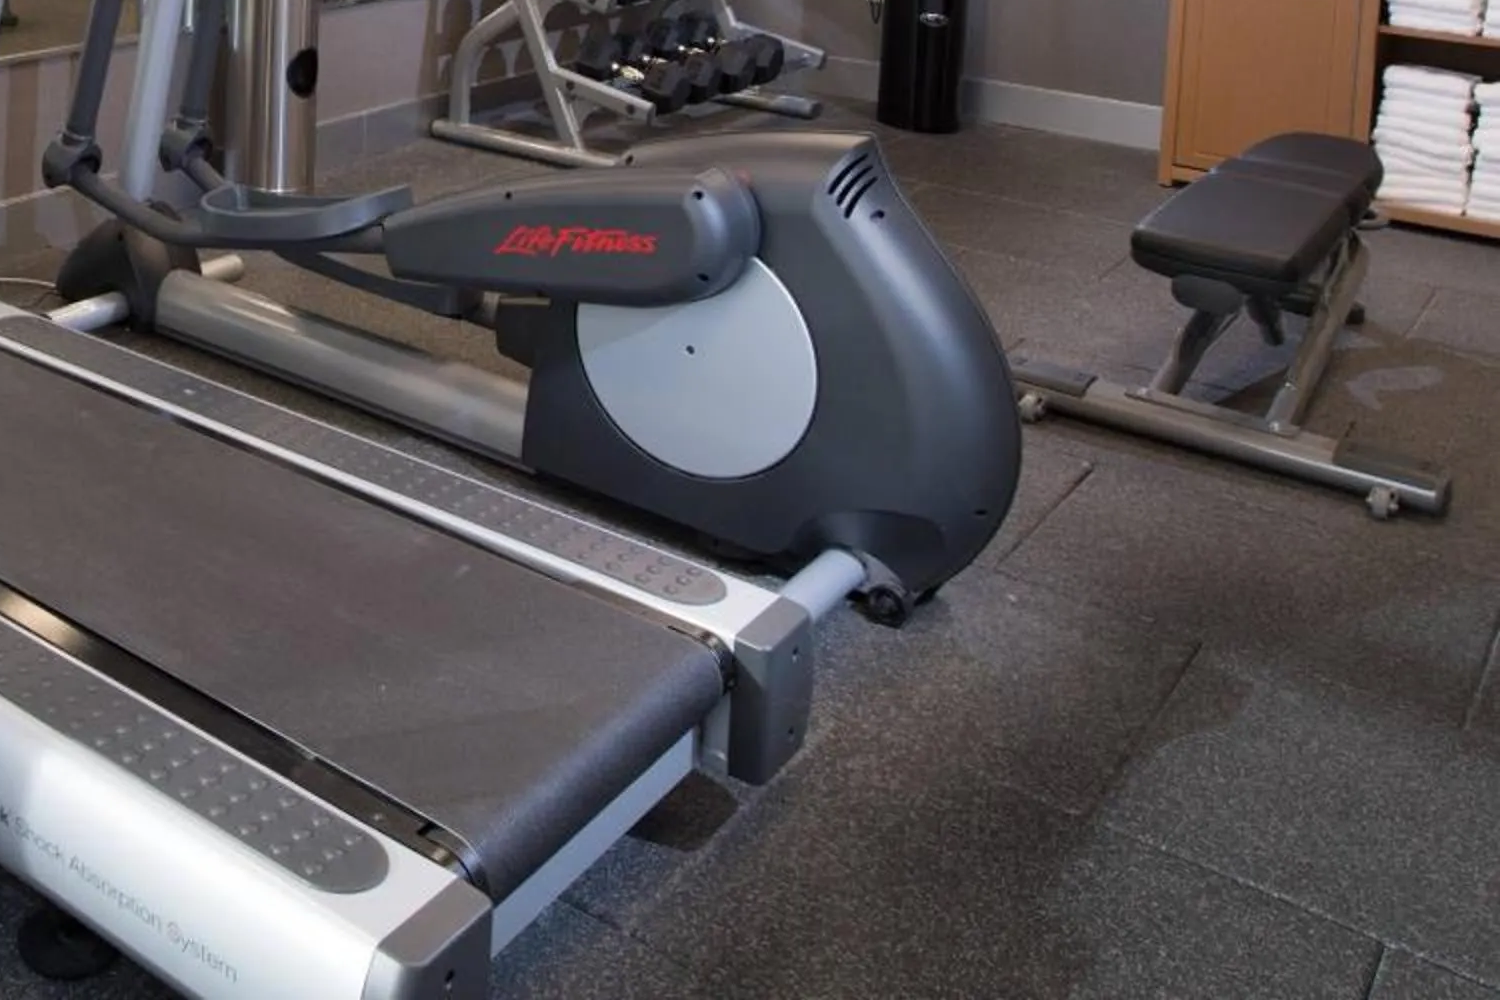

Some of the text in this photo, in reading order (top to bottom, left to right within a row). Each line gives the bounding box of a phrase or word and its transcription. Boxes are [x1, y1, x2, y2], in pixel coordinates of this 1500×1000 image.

[493, 224, 658, 257] Life Fitness
[69, 854, 164, 932] Absorption
[166, 921, 239, 983] System
